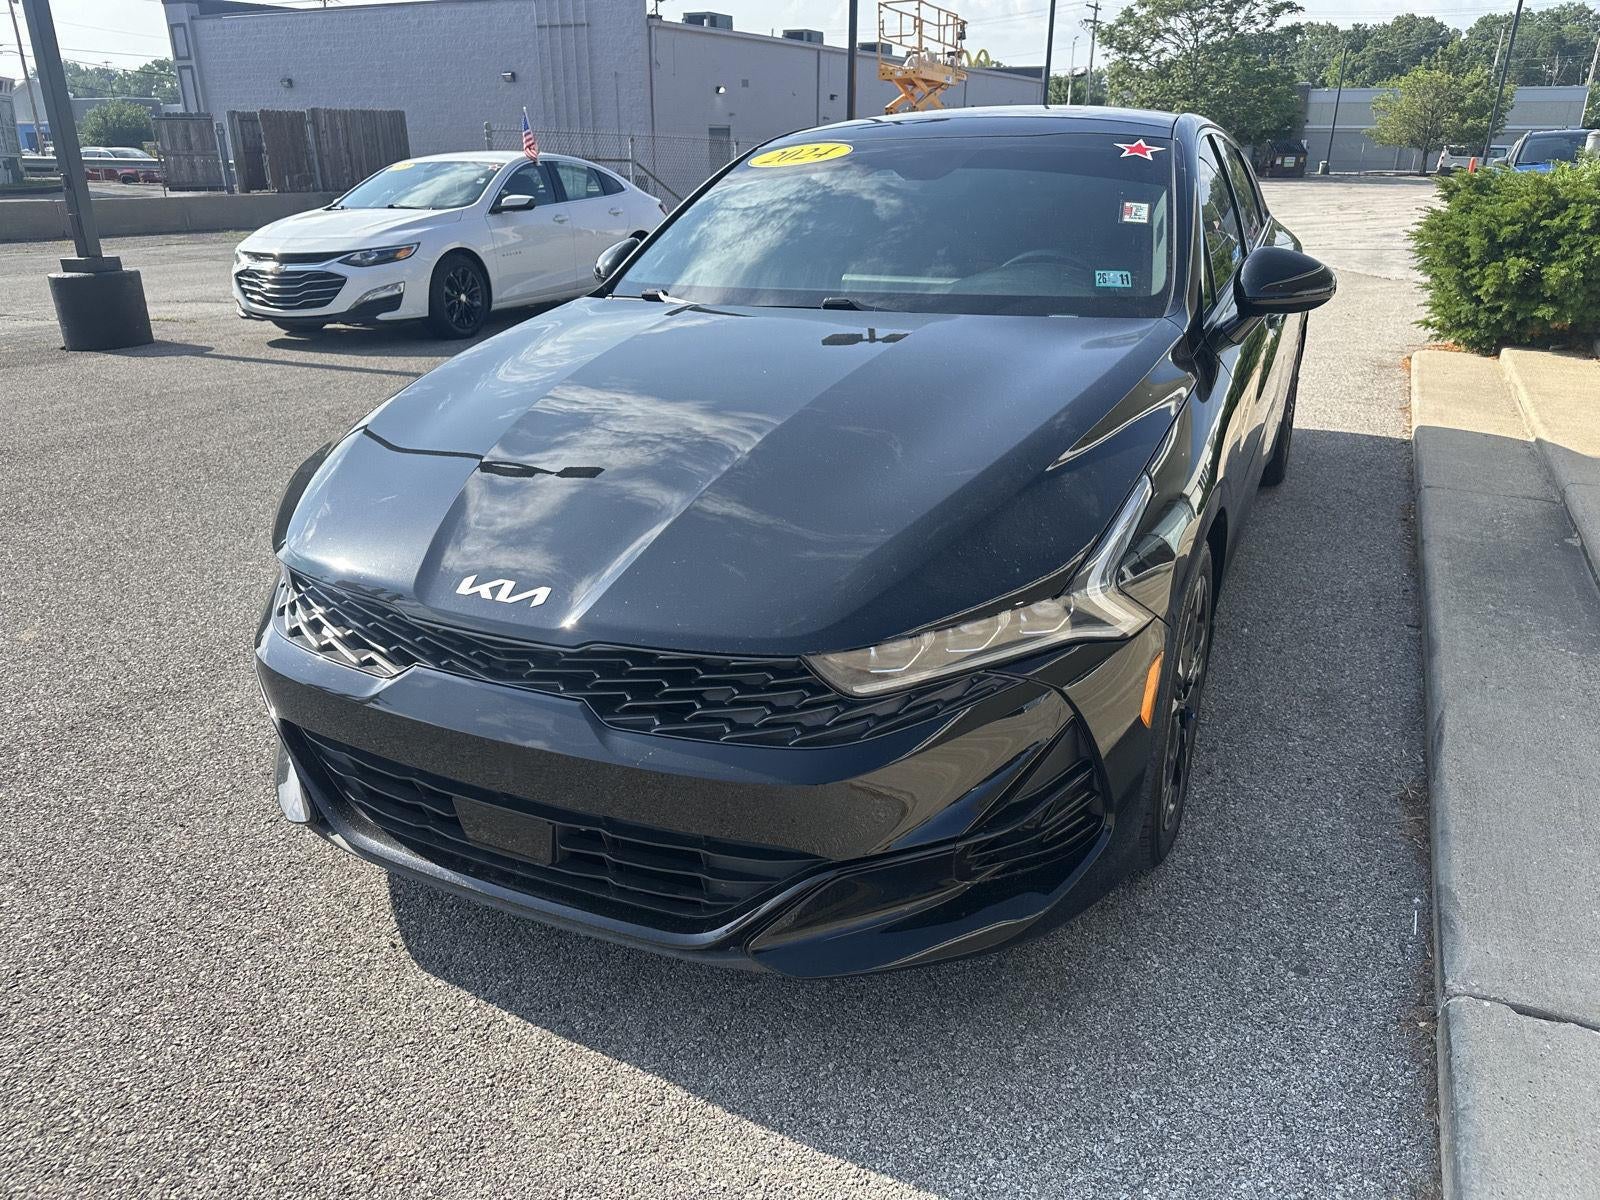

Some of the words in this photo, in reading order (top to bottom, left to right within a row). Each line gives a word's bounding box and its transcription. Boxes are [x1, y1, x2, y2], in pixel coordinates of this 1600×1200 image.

[759, 146, 840, 164] 2024
[1097, 273, 1107, 284] 26
[1119, 273, 1129, 285] 11
[456, 574, 552, 608] KIA
